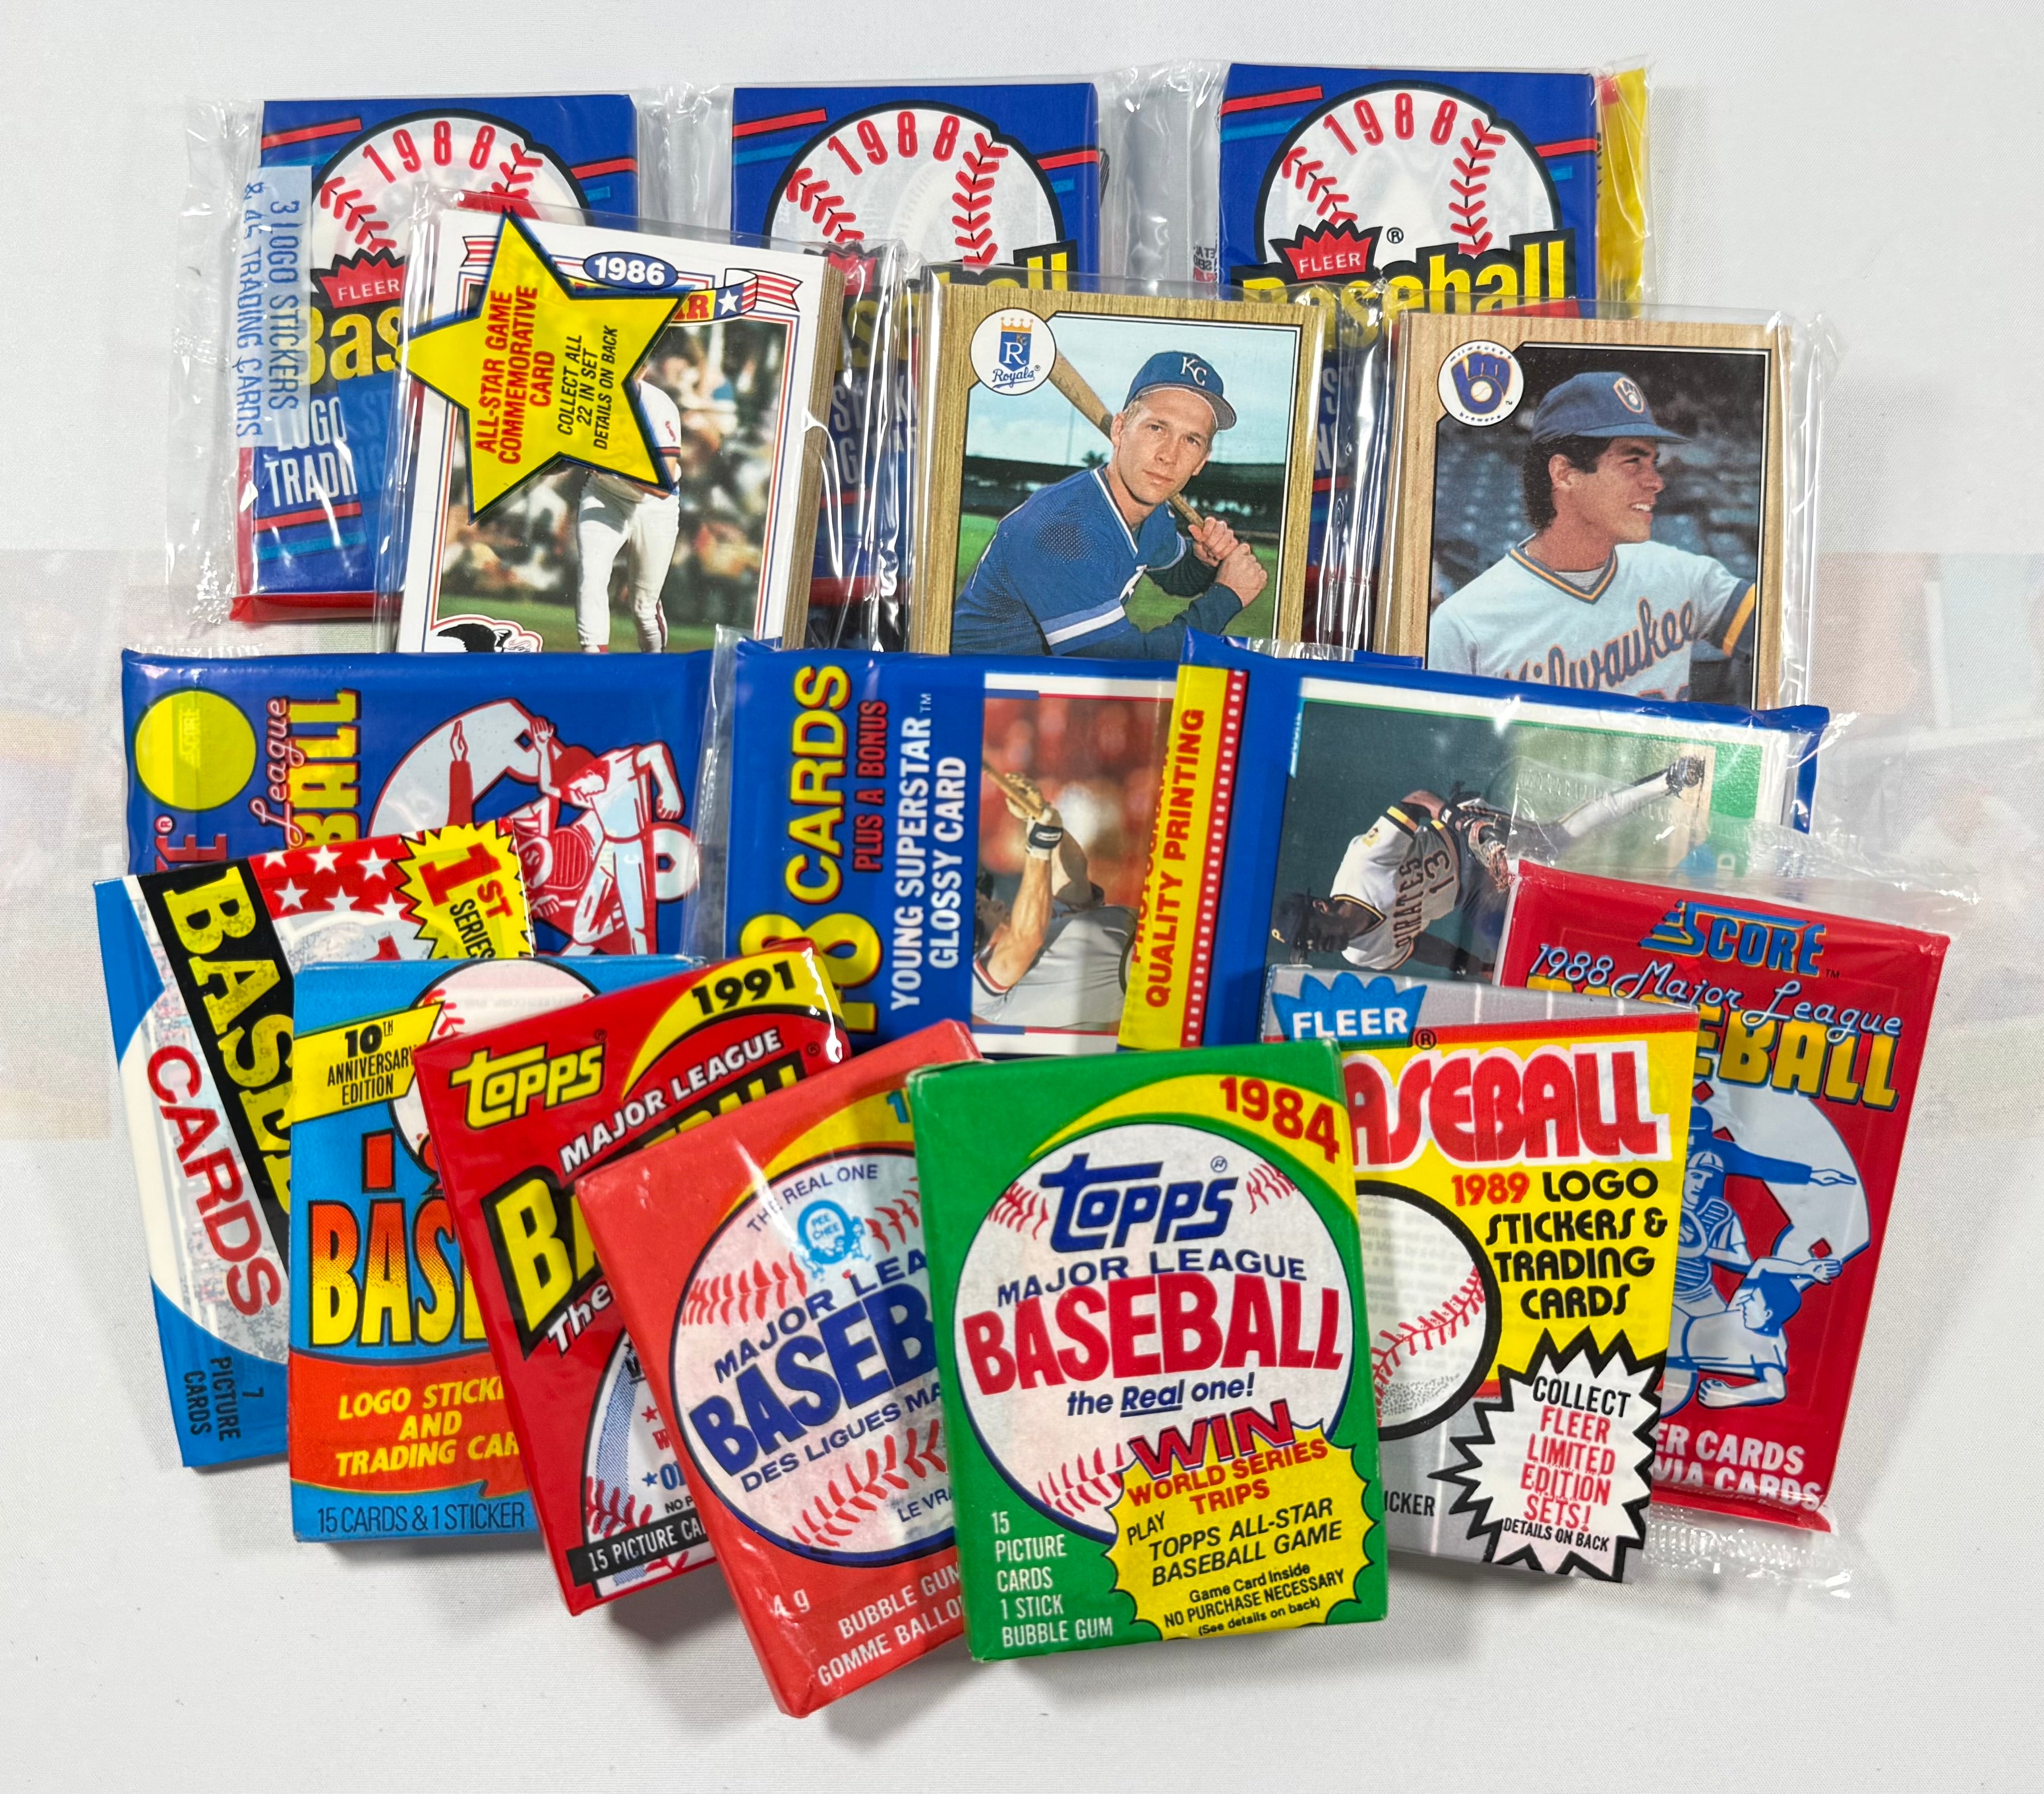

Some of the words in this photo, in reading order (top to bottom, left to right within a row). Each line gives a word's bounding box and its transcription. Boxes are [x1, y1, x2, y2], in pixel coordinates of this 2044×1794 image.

[827, 110, 960, 176] 1988
[1322, 92, 1458, 155] 1988
[362, 120, 496, 184] 1988
[244, 182, 264, 200] &
[270, 200, 300, 214] 3
[338, 278, 401, 301] FLEER
[594, 256, 665, 286] 1986
[1299, 251, 1362, 274] FLEER
[237, 246, 263, 349] TRADING
[485, 290, 512, 351] GAME
[269, 295, 300, 411] STICKERS
[565, 334, 583, 363] ALL
[582, 348, 598, 380] SET
[603, 324, 618, 364] BACK
[236, 359, 264, 438] CARDS
[497, 285, 538, 465] COMMEMORATIVE
[529, 351, 556, 408] CARD
[557, 366, 579, 435] COLLECT
[581, 381, 595, 399] IN
[598, 369, 614, 390] ON
[991, 367, 1035, 389] Royals
[475, 357, 505, 454] ALL-STAR
[576, 402, 592, 427] 22
[593, 394, 612, 450] DETAILS
[857, 700, 889, 779] BONUS
[249, 696, 306, 850] League
[289, 688, 361, 848] BALL
[785, 665, 852, 903] CARDS
[1162, 707, 1205, 861] PRINTING
[856, 787, 886, 806] A
[895, 716, 932, 898] SUPERSTAR
[933, 756, 967, 843] CARD
[854, 813, 883, 873] PLUS
[419, 841, 513, 919] 1ST
[928, 851, 964, 969] GLOSSY
[1144, 867, 1183, 1008] QUALITY
[891, 904, 924, 1011] YOUNG
[1639, 898, 1827, 978] SCORE
[691, 960, 798, 1017] 1991
[1529, 943, 1615, 987] 1988
[1610, 959, 1742, 1009] Major
[1742, 979, 1904, 1044] League
[1292, 1007, 1409, 1041] FLEER
[342, 1075, 394, 1106] EDITION
[560, 1089, 668, 1176] MAJOR
[672, 1026, 784, 1102] LEAGUE
[1342, 1045, 1667, 1169] ASEBALL
[1219, 1076, 1340, 1165] 1984
[146, 1043, 282, 1317] CARDS
[783, 1174, 833, 1205] REAL
[837, 1164, 879, 1183] ONE
[1450, 1171, 1530, 1207] 1989
[1543, 1167, 1659, 1203] LOGO
[1485, 1207, 1636, 1247] STICKERS
[1643, 1208, 1669, 1239] &
[997, 1254, 1129, 1308] MAJOR
[1149, 1248, 1307, 1282] LEAGUE
[1494, 1245, 1656, 1283] TRADING
[547, 1282, 612, 1355] The
[714, 1289, 838, 1384] MAJOR
[848, 1248, 928, 1297] LEA
[1520, 1284, 1631, 1320] CARDS
[963, 1272, 1344, 1396] BASEBALL
[182, 1370, 212, 1437] CARDS
[210, 1355, 242, 1442] PICTURE
[242, 1387, 264, 1400] 7
[338, 1386, 411, 1420] LOGO
[423, 1376, 504, 1410] STICK
[689, 1283, 939, 1477] BASEB
[1067, 1390, 1114, 1417] the
[1120, 1379, 1186, 1416] Real
[1191, 1371, 1255, 1402] one!
[1532, 1375, 1631, 1418] COLLECT
[398, 1409, 462, 1441] AND
[741, 1452, 799, 1493] DES
[804, 1401, 902, 1462] LIGUES
[1128, 1397, 1297, 1480] WIN
[1539, 1405, 1612, 1445] FLEER
[1696, 1429, 1806, 1475] CARDS
[336, 1439, 456, 1478] TRADING
[468, 1431, 520, 1461] CAR
[1126, 1464, 1227, 1508] WORLD
[1231, 1438, 1329, 1481] SERIES
[1526, 1433, 1616, 1476] LIMITED
[664, 1499, 684, 1514] NO
[1189, 1478, 1271, 1516] TRIPS
[1384, 1489, 1436, 1517] ICKER
[1519, 1462, 1612, 1507] EDITION
[1653, 1455, 1704, 1486] VIA
[1713, 1467, 1823, 1512] CARDS
[317, 1507, 339, 1534] 15
[342, 1505, 408, 1534] CARDS
[412, 1505, 429, 1532] &
[432, 1505, 439, 1531] 1
[444, 1502, 526, 1531] STICKER
[898, 1501, 922, 1523] LE
[990, 1511, 1010, 1534] 15
[1126, 1511, 1166, 1546] PLAY
[1149, 1525, 1222, 1562] TOPPS
[1228, 1497, 1334, 1542] ALL-STAR
[1503, 1516, 1553, 1541] DETAILS
[1555, 1527, 1573, 1545] ON
[1576, 1532, 1610, 1552] BACK
[1523, 1493, 1592, 1532] SETS!
[588, 1548, 609, 1573] 15
[611, 1524, 678, 1565] PICTURE
[994, 1533, 1068, 1563] PICTURE
[1151, 1540, 1267, 1587] BASEBALL
[1273, 1520, 1343, 1555] GAME
[996, 1566, 1054, 1593] CARDS
[1000, 1598, 1009, 1620] 1
[1015, 1594, 1064, 1619] STICK
[1163, 1610, 1185, 1628] NO
[1187, 1593, 1264, 1623] PURCHASE
[1264, 1568, 1346, 1603] NECESSARY
[1189, 1585, 1231, 1603] Game
[1232, 1573, 1267, 1594] Card
[1268, 1562, 1311, 1585] Inside
[837, 1585, 918, 1640] BUBBLE
[1001, 1620, 1070, 1648] BUBBLE
[1075, 1616, 1113, 1641] GUM
[1198, 1621, 1225, 1636] (See
[1227, 1610, 1268, 1629] details
[1270, 1607, 1286, 1619] on
[1288, 1596, 1321, 1614] back)
[817, 1633, 893, 1686] GOMME
[894, 1595, 964, 1645] BALLO
